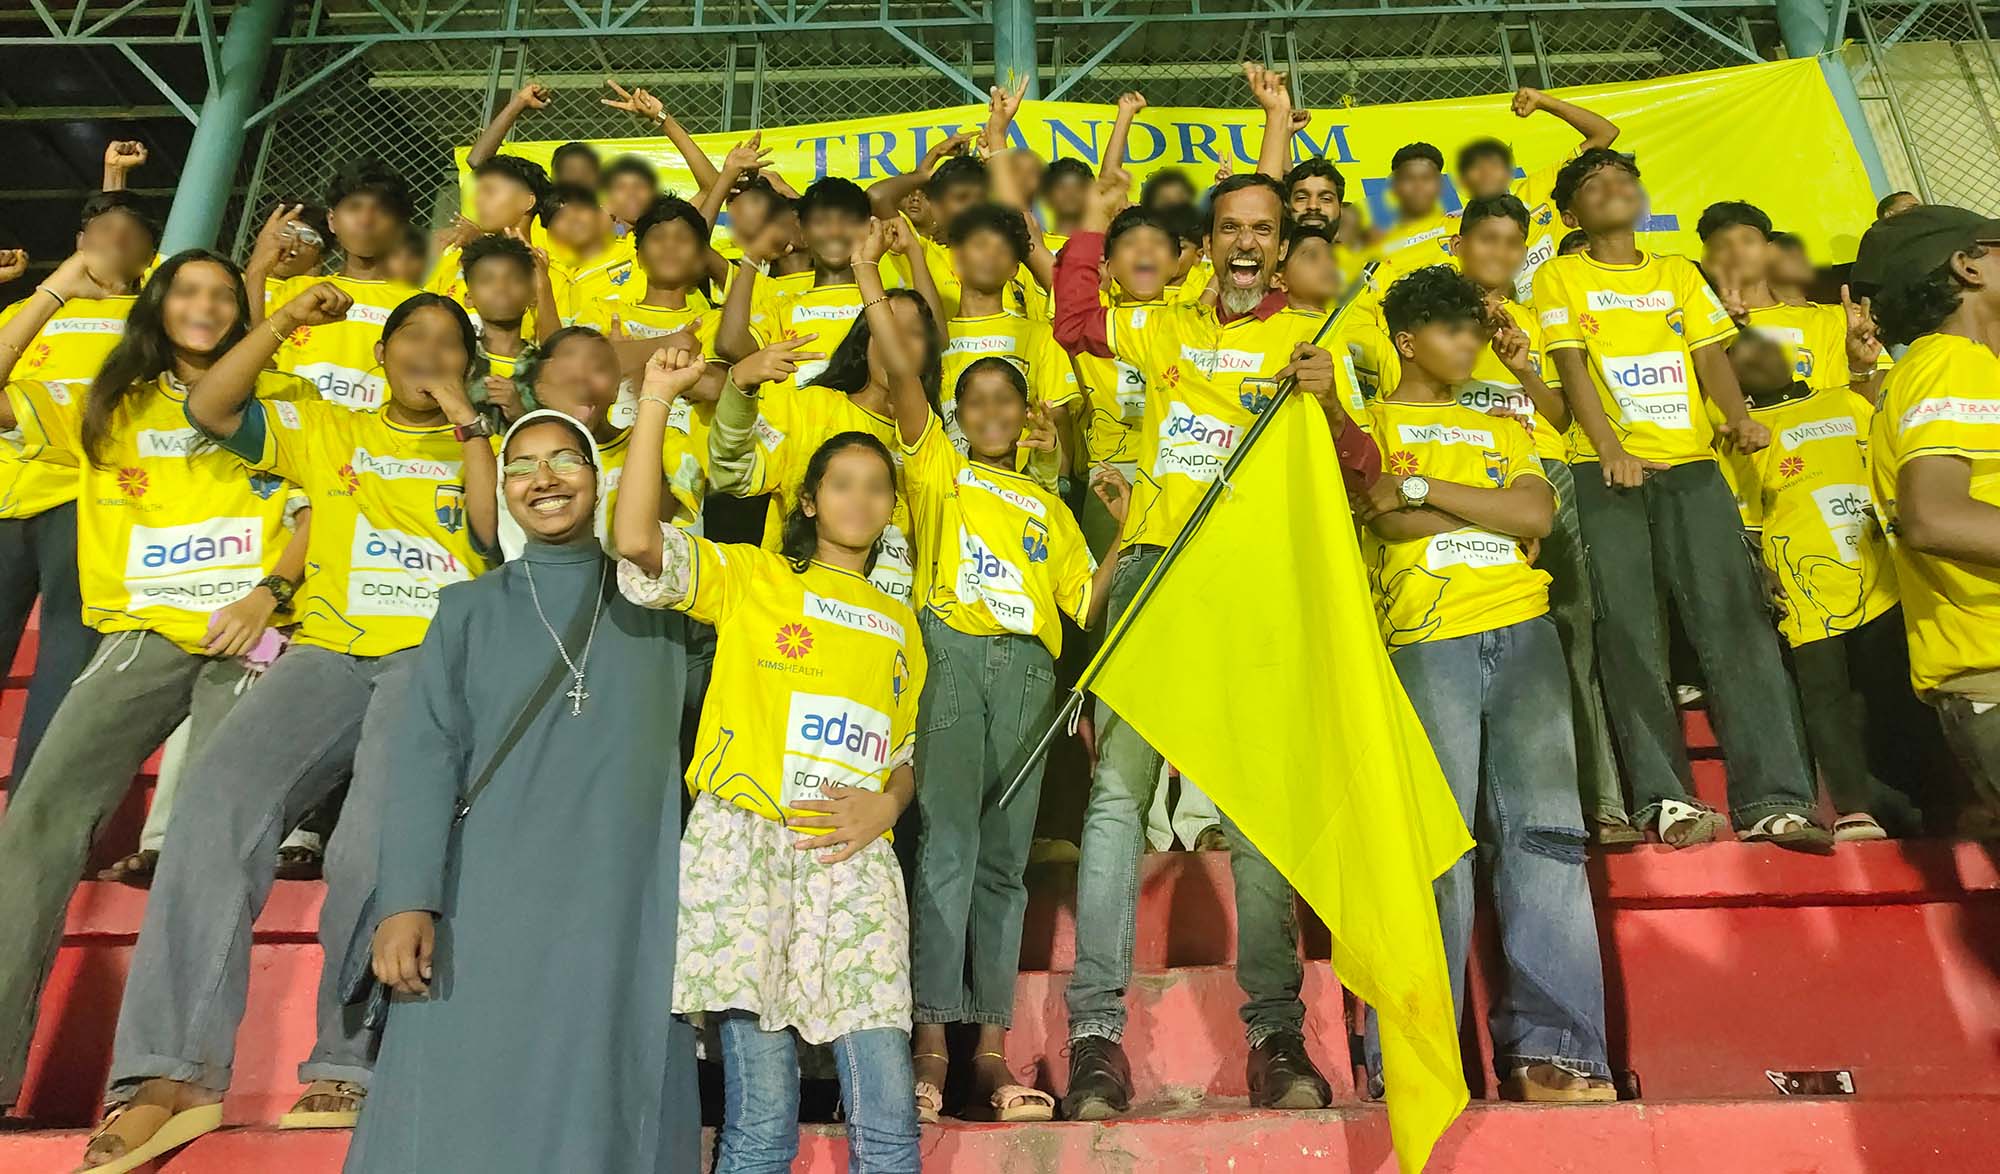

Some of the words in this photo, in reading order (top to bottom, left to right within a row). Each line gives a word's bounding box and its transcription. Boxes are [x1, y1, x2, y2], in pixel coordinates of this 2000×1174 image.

[348, 307, 387, 324] TSUN
[311, 372, 376, 403] dani
[1459, 387, 1530, 409] adani
[757, 420, 780, 443] VELS
[1168, 414, 1235, 449] adani
[1788, 421, 1854, 443] WATTSUN
[1161, 447, 1224, 467] CONDO
[143, 528, 252, 568] adani
[815, 598, 902, 639] WATTSUN
[757, 658, 824, 678] KIMSHEALTH
[801, 711, 890, 765] adani
